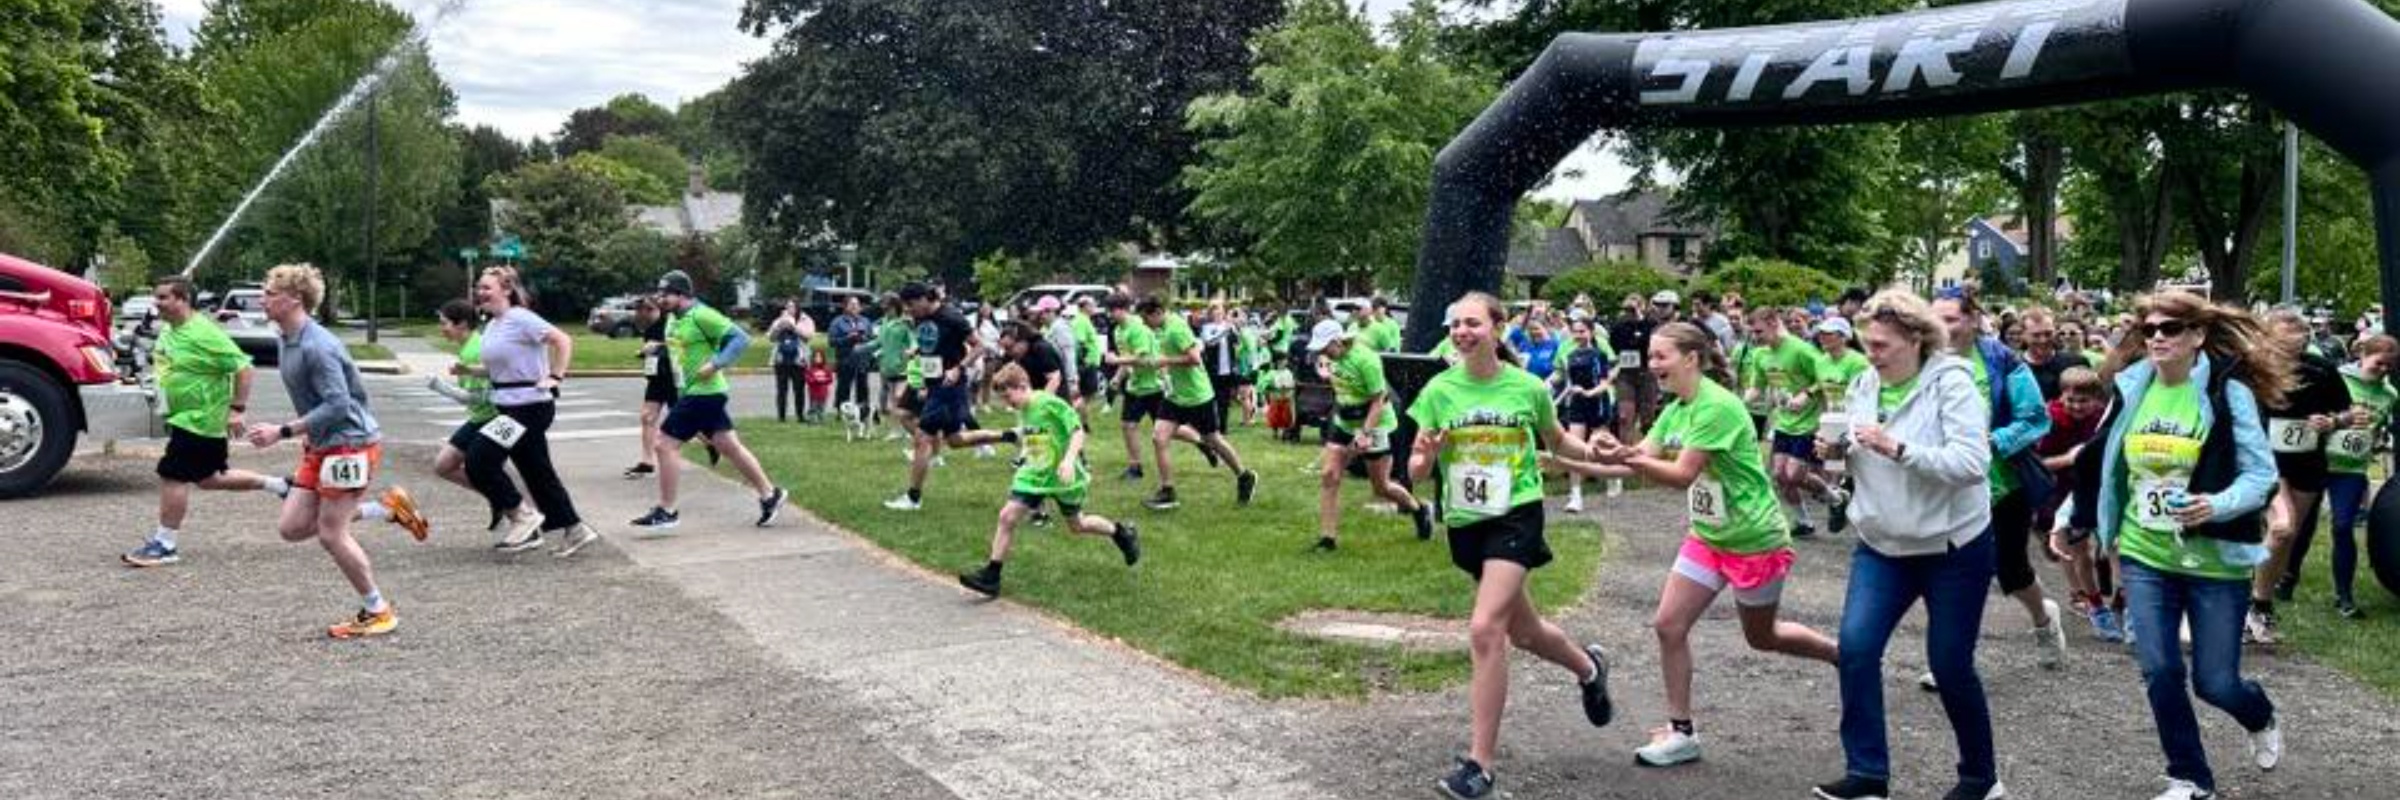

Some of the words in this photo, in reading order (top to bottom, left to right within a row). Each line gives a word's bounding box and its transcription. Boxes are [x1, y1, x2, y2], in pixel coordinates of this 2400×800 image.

[1639, 6, 2064, 104] START
[2284, 427, 2303, 445] 27
[331, 461, 360, 480] 141
[1465, 477, 1487, 505] 84
